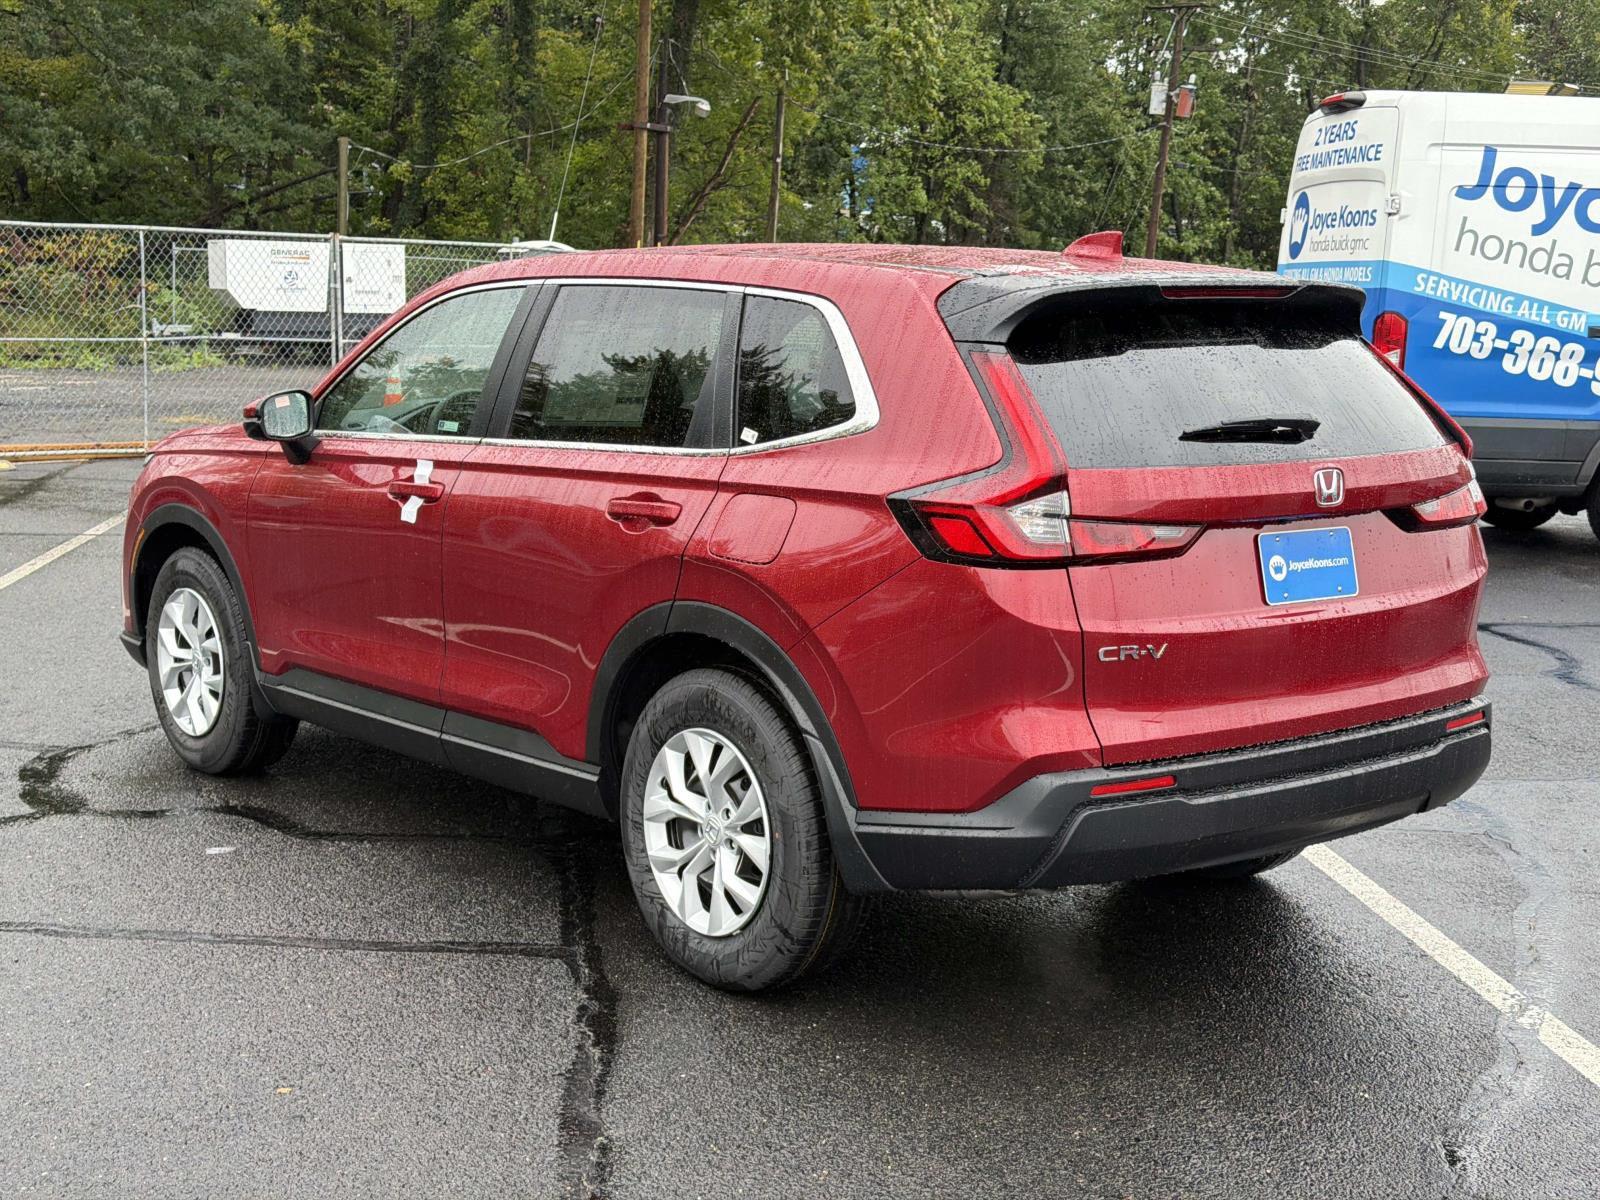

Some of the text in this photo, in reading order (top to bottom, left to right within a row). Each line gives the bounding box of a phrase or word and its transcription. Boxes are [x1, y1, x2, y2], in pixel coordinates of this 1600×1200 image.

[1314, 120, 1359, 146] 2 YEARS
[1310, 144, 1383, 169] MAINTENANCE
[1309, 205, 1377, 236] Joyce Koons
[1309, 234, 1370, 255] honda buick gmc
[1454, 216, 1574, 281] honda
[1323, 267, 1343, 281] HONDA
[1343, 266, 1373, 282] MODELS
[1413, 273, 1588, 333] SERVICING ALL GM
[1288, 556, 1349, 573] JoyceKoons.com
[1098, 643, 1169, 662] CR-V
